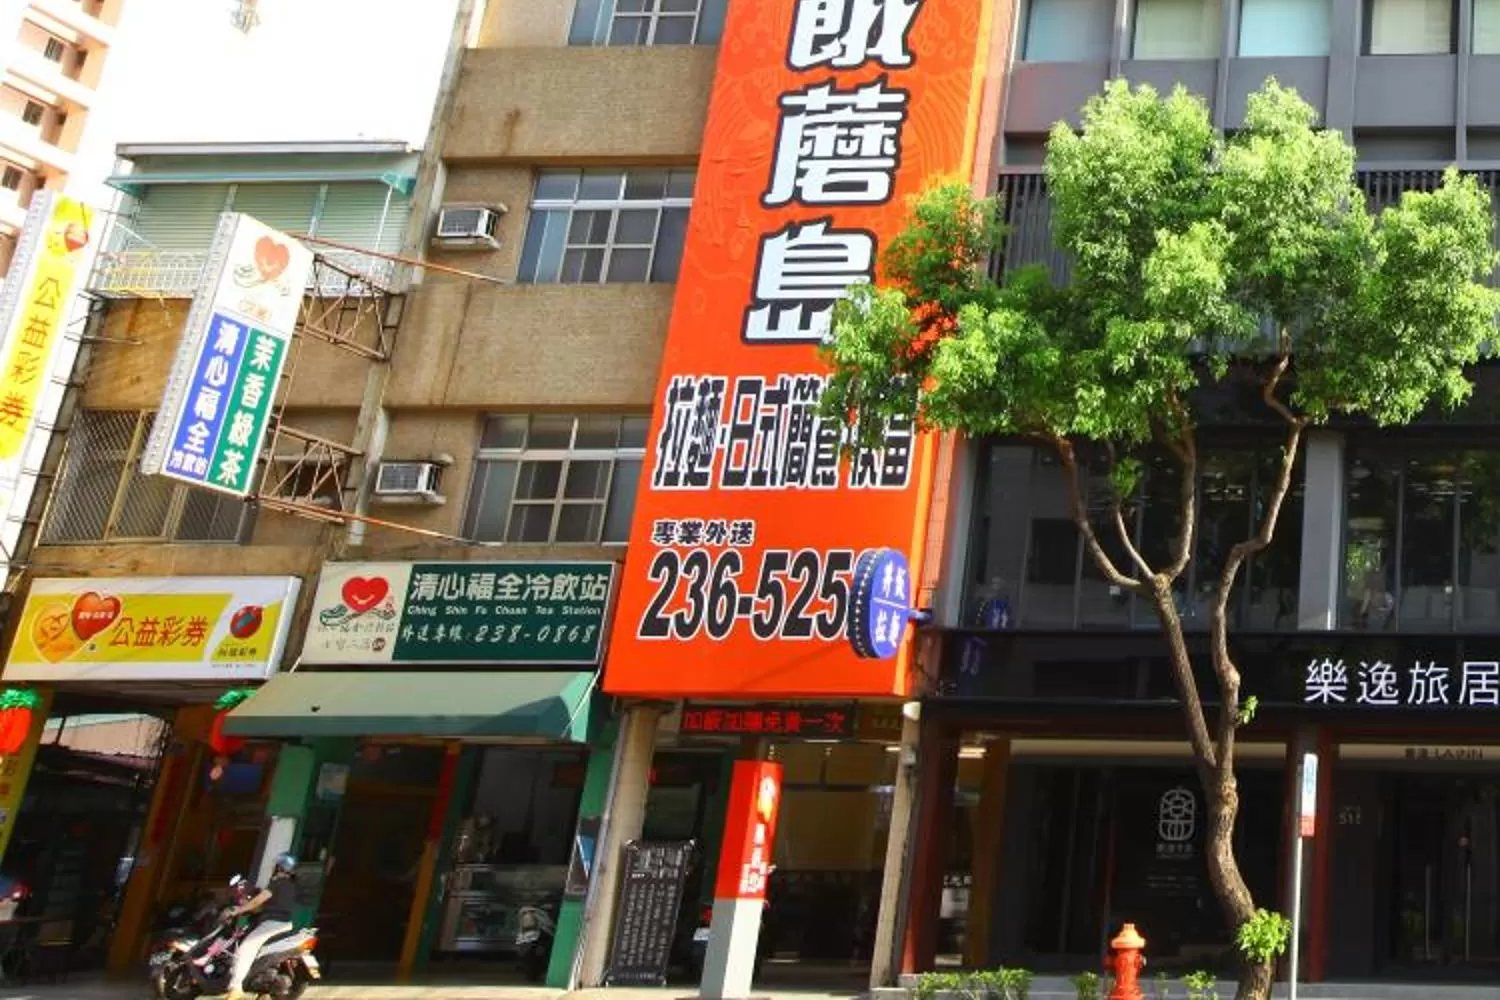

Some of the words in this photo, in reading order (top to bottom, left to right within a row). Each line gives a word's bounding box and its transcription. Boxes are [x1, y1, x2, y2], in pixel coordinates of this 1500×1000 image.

[183, 319, 241, 454] 清心福全
[216, 336, 277, 485] 茉香綠茶
[651, 518, 756, 546] 專業外送
[410, 572, 609, 601] 清心福全冷飲站
[636, 548, 860, 640] 236-525
[407, 605, 437, 616] Ching
[445, 605, 468, 615] Shin
[495, 605, 528, 616] Chuan
[536, 606, 554, 616] Tea
[562, 606, 601, 616] Station
[108, 615, 209, 648] 公益彩券
[474, 624, 597, 644] 238-0868
[1304, 657, 1500, 705] 樂逸旅居
